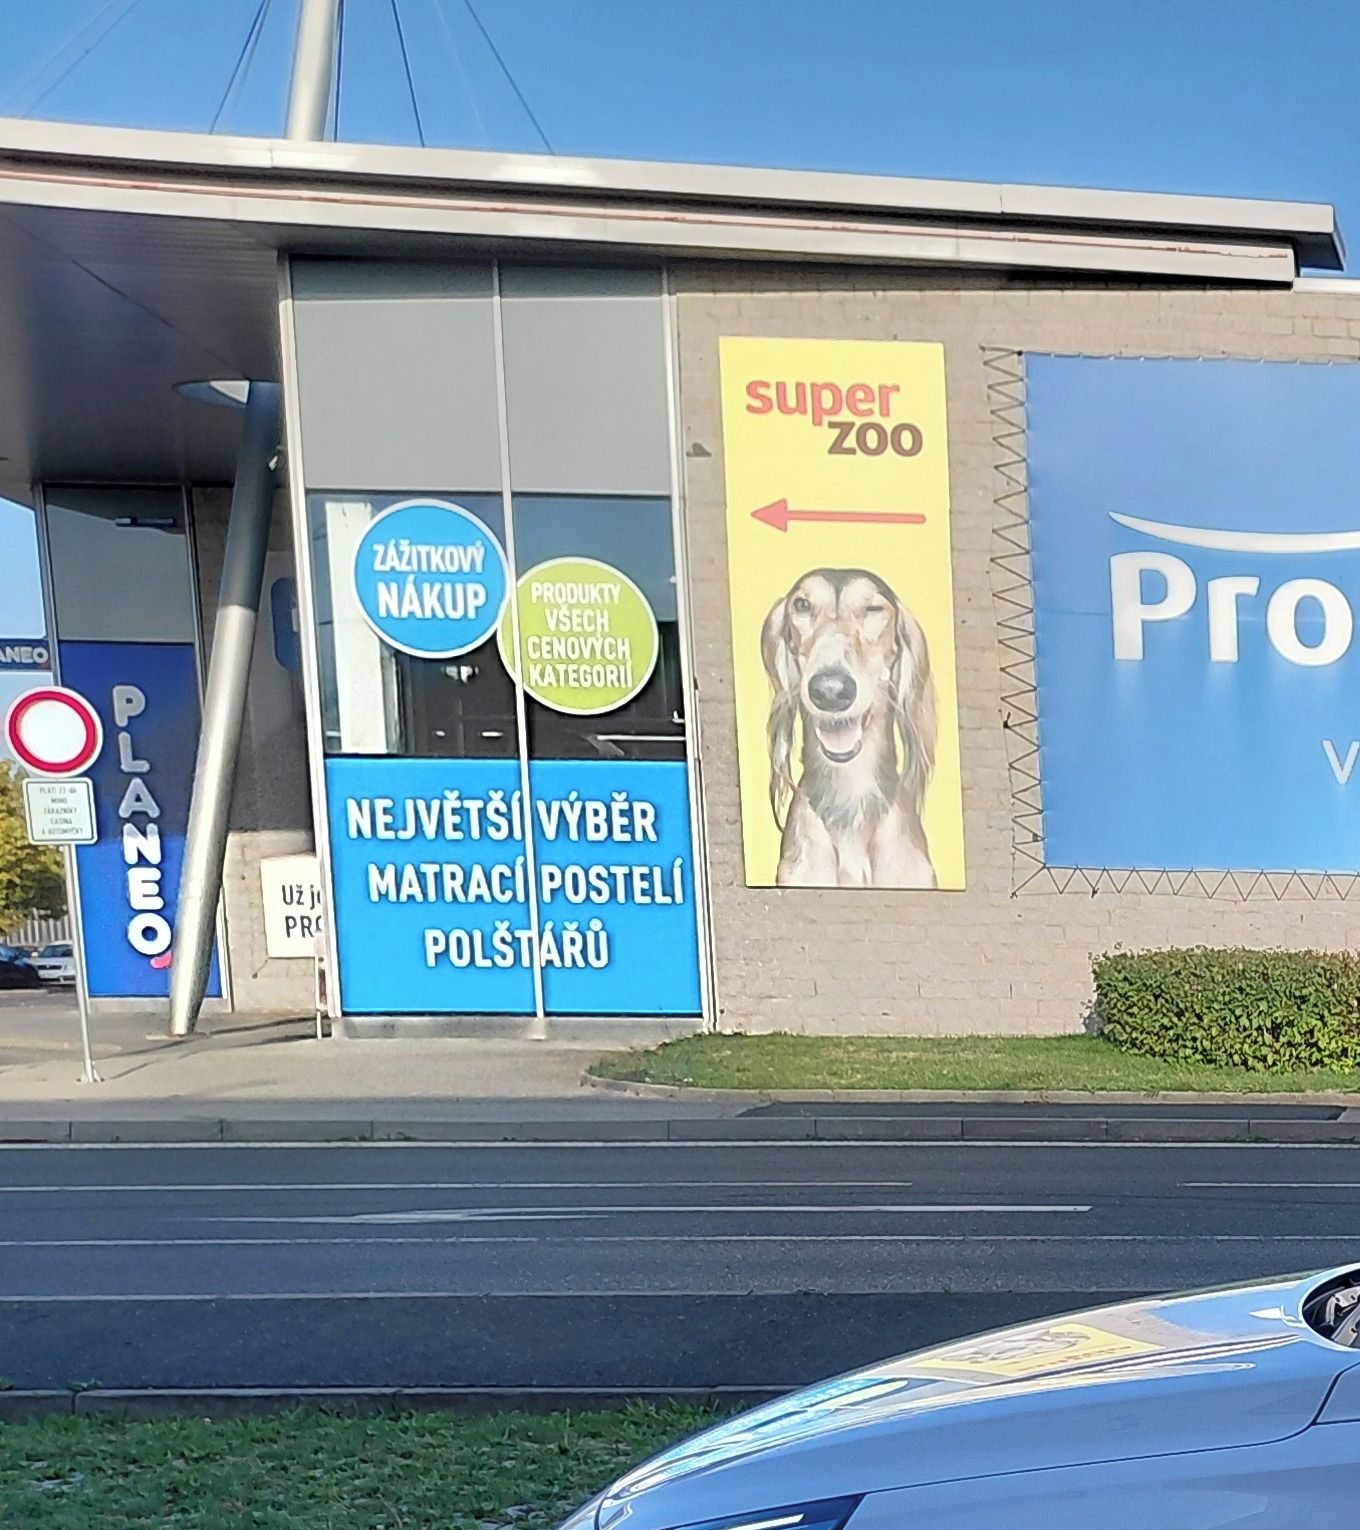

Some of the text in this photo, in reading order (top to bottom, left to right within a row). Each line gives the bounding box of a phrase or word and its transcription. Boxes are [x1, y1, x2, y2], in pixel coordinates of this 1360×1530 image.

[745, 380, 901, 426] super
[372, 538, 486, 573] ZÁŽITKOVÝ
[377, 574, 488, 620] NÁKUP
[531, 581, 621, 605] PRODUKTY
[544, 602, 610, 632] VŠECH
[527, 634, 631, 661] CENOVÝCH
[529, 659, 633, 689] KATEGORIÍ
[111, 684, 172, 956] PLANEO
[346, 789, 658, 842] NEJVĚTŠÍ VÝBĚR
[281, 884, 305, 905] Už
[367, 856, 685, 904] MATRACÍ POSTELÍ
[424, 918, 609, 968] POLŠTÁŘŮ
